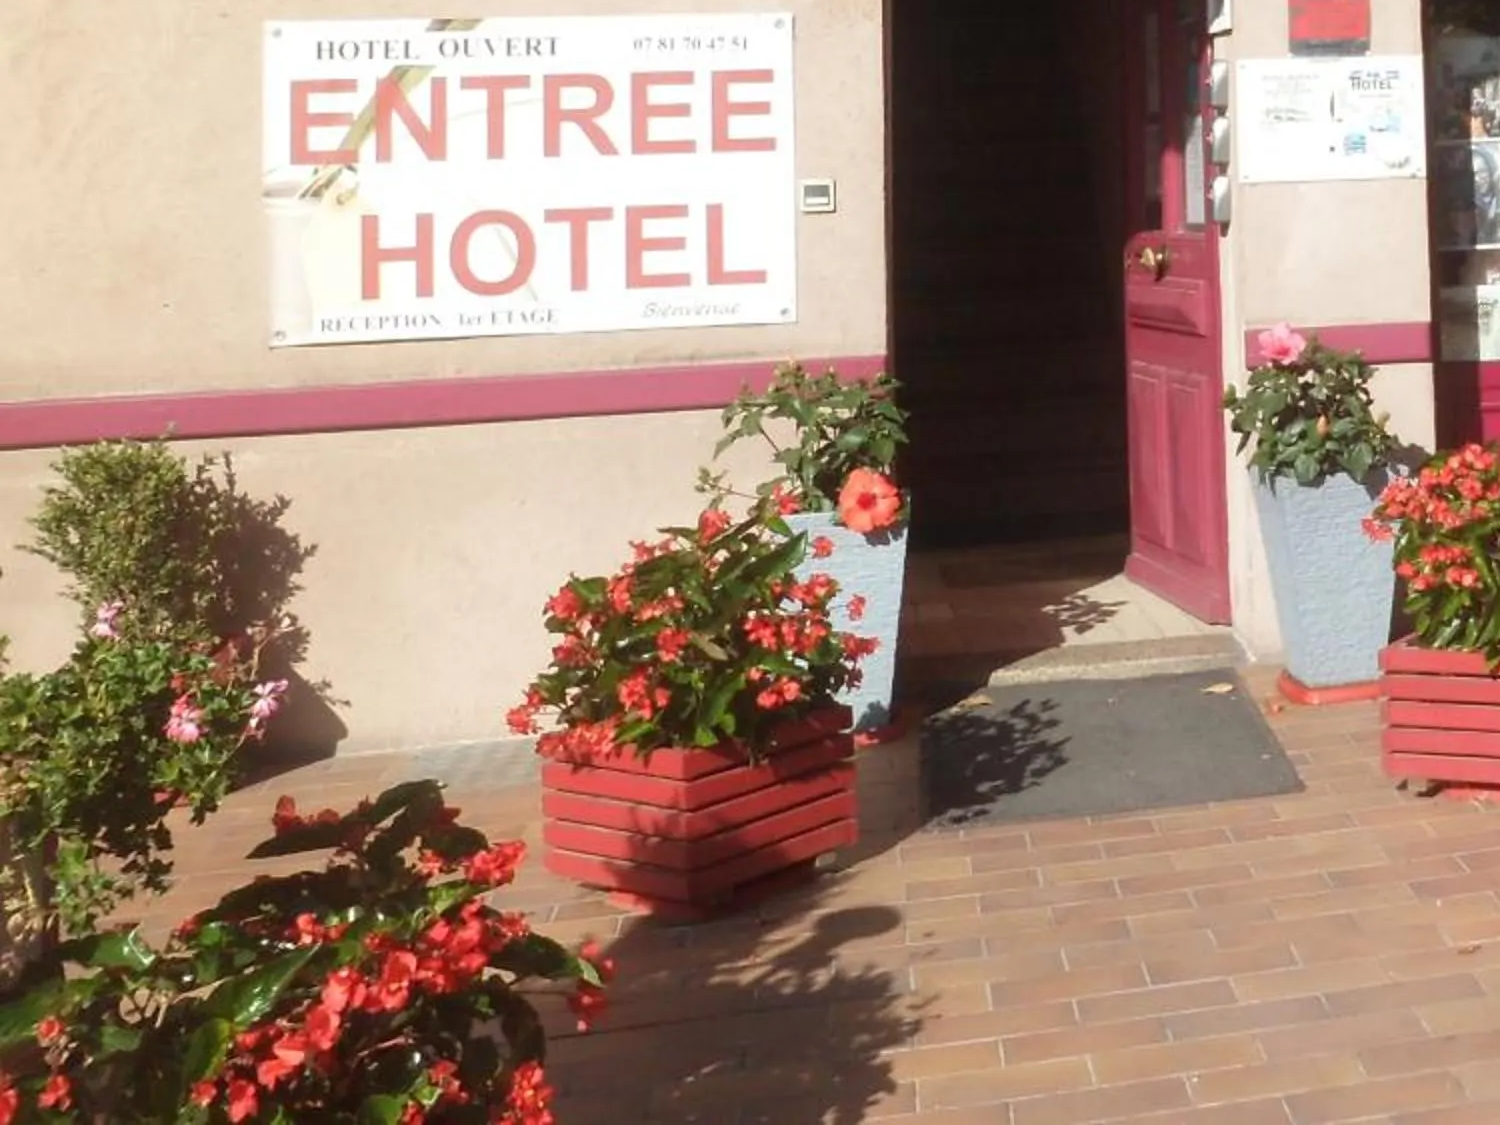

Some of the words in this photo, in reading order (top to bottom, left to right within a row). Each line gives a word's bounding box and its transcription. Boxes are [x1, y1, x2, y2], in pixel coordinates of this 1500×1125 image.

[316, 39, 419, 60] HOTEL
[439, 36, 560, 59] OUVERT
[290, 69, 776, 165] ENTREE
[361, 203, 767, 300] HOTEL
[320, 313, 442, 333] RECEPTION
